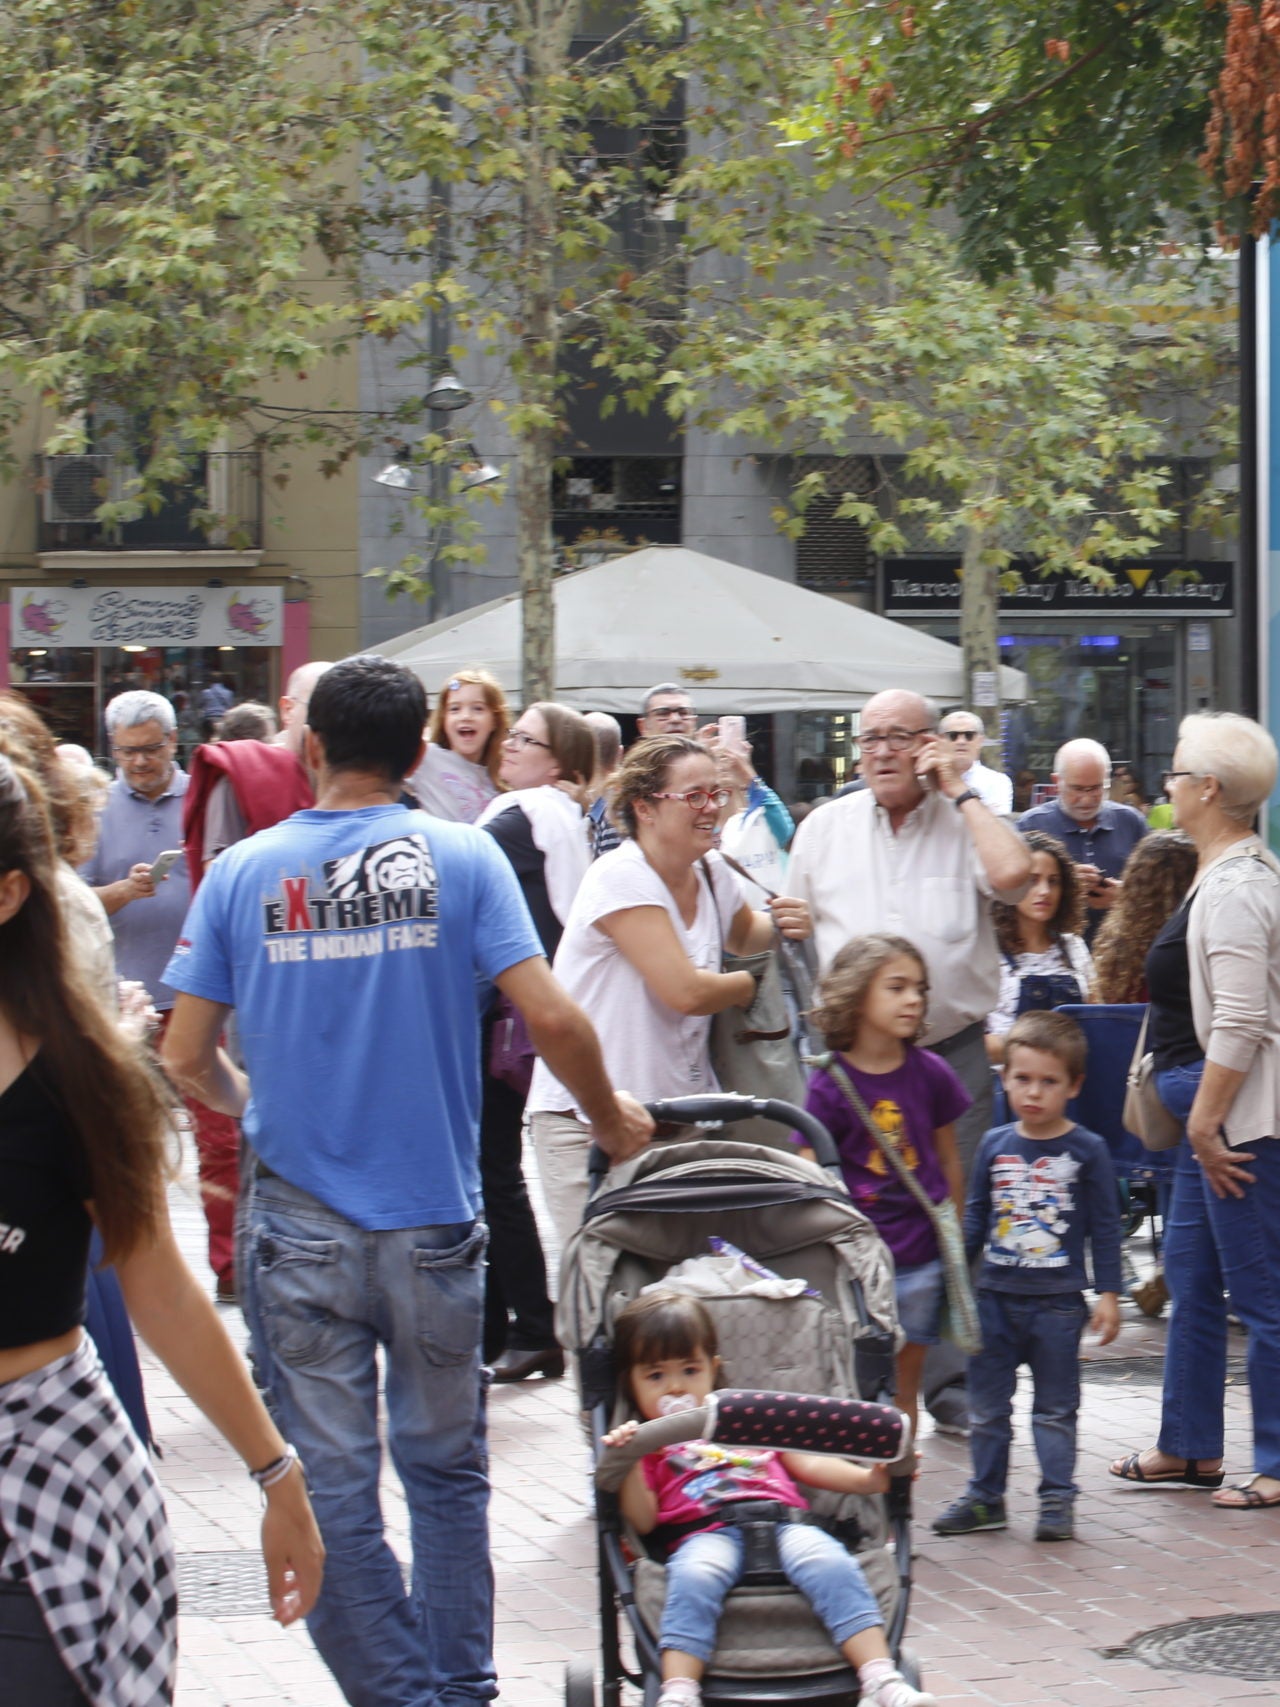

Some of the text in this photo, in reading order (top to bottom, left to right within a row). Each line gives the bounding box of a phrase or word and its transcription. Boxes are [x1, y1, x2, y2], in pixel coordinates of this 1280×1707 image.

[264, 877, 439, 934] EXTREME
[264, 924, 438, 963] THE INDIAN FACE
